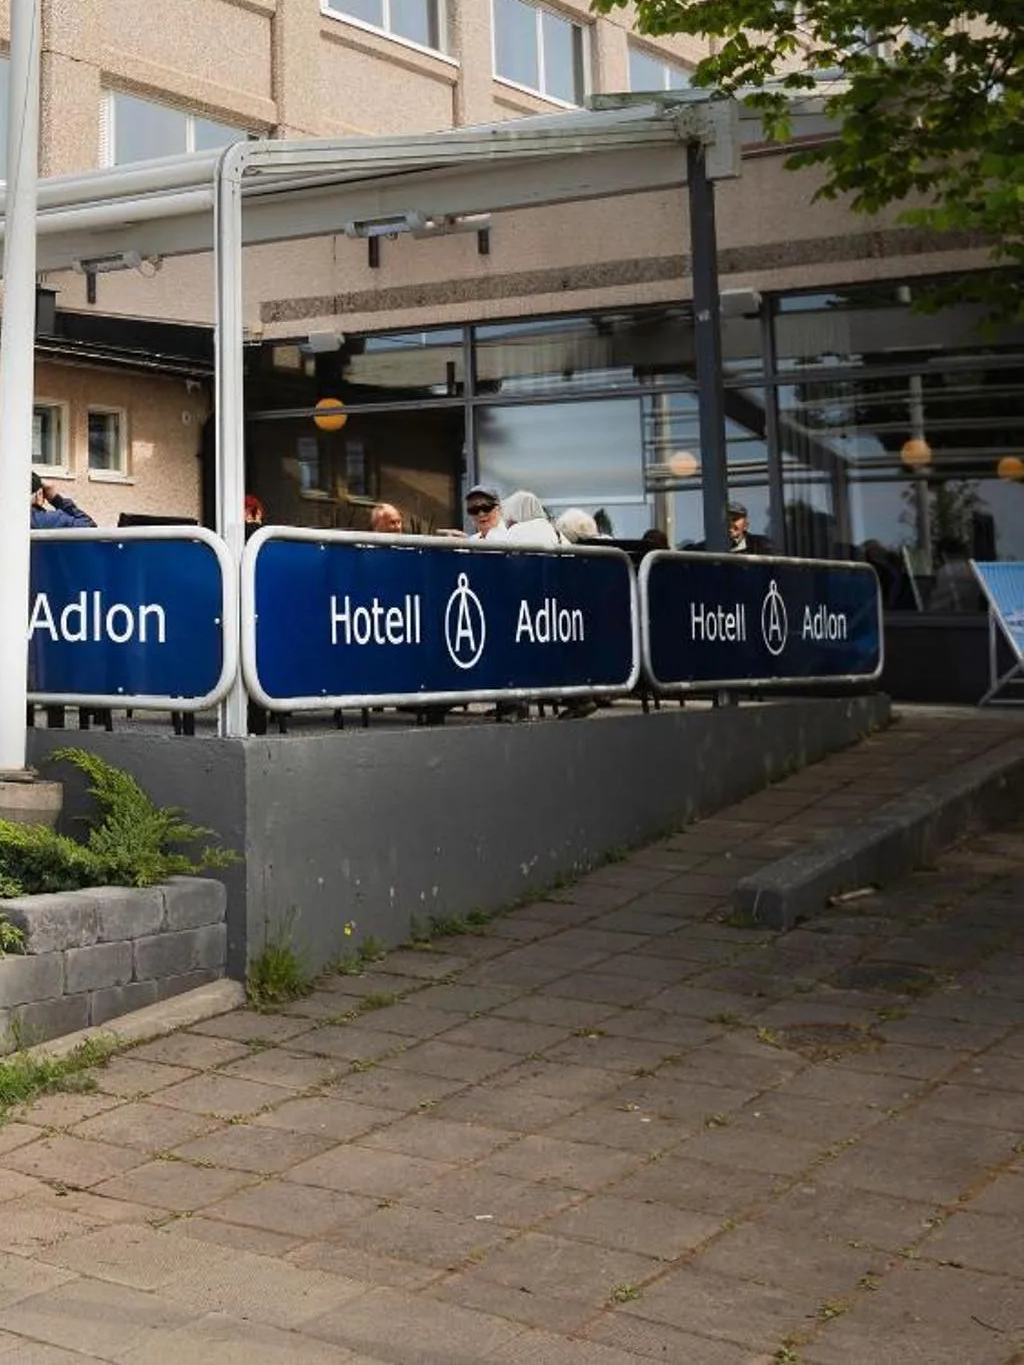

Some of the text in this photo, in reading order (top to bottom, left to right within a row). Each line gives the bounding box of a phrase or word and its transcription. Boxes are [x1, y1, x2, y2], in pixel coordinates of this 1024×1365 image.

[26, 590, 166, 643] Adlon
[330, 594, 421, 645] Hotell
[515, 597, 585, 643] Adlon
[689, 602, 746, 642] Hotell
[801, 603, 848, 641] Adlon
